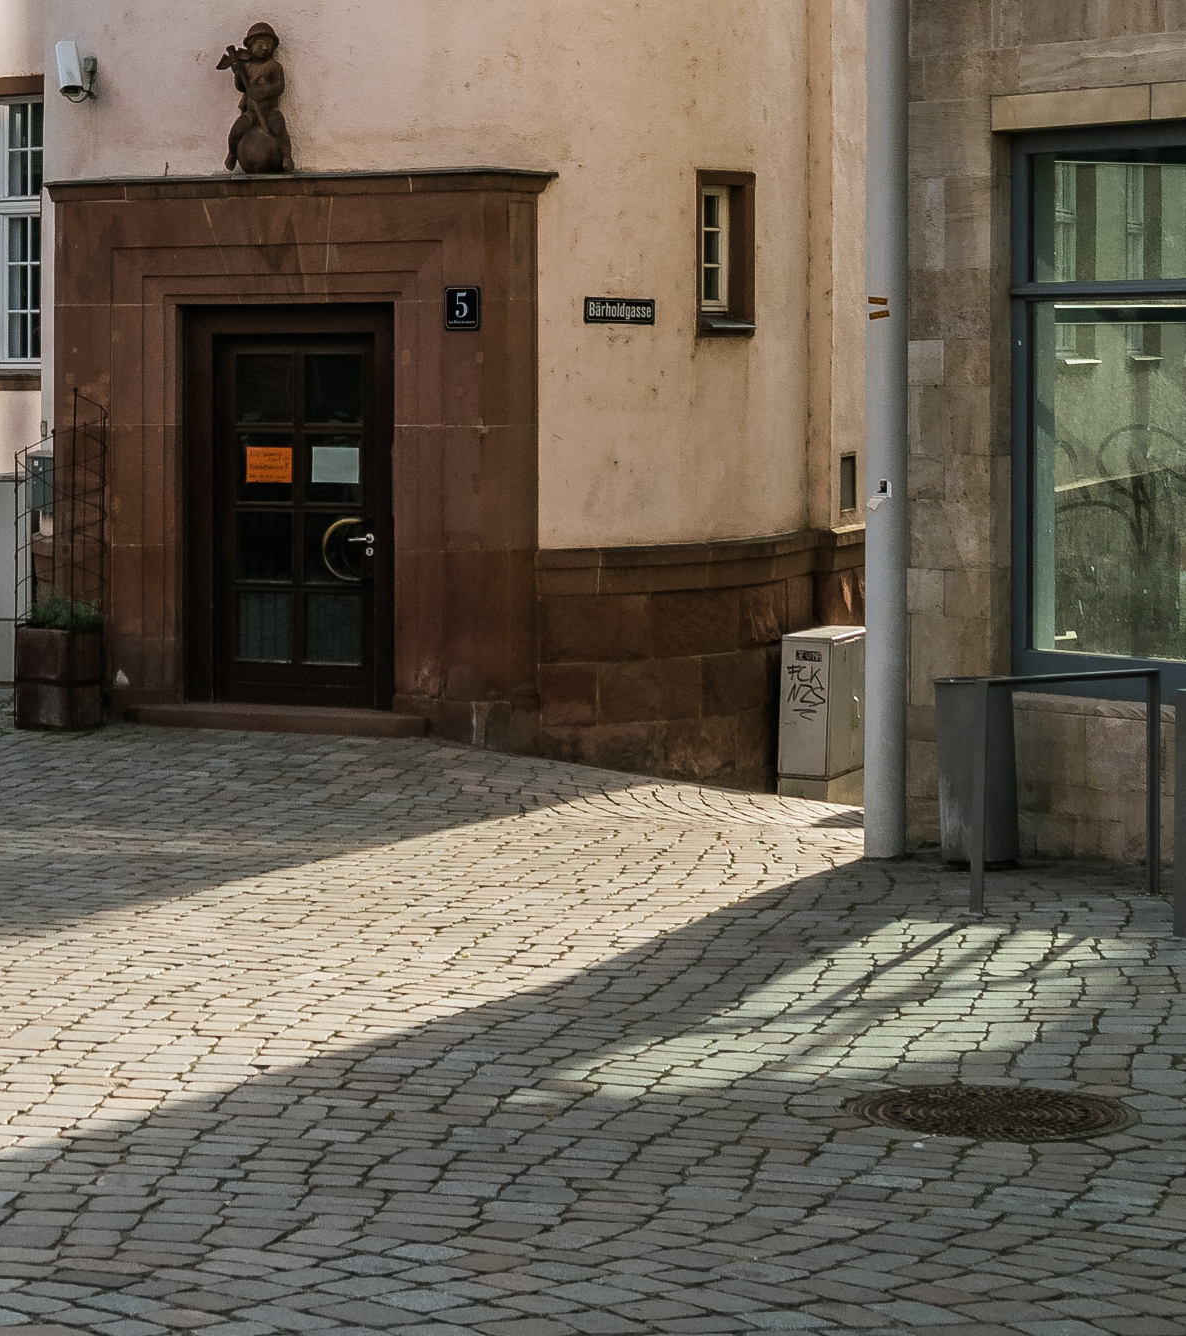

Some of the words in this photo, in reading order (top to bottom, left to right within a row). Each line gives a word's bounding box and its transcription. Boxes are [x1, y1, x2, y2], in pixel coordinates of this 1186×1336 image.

[455, 291, 468, 318] 5
[588, 301, 652, 320] Bärholdgasse
[787, 664, 825, 692] FCK
[787, 683, 826, 707] NZS
